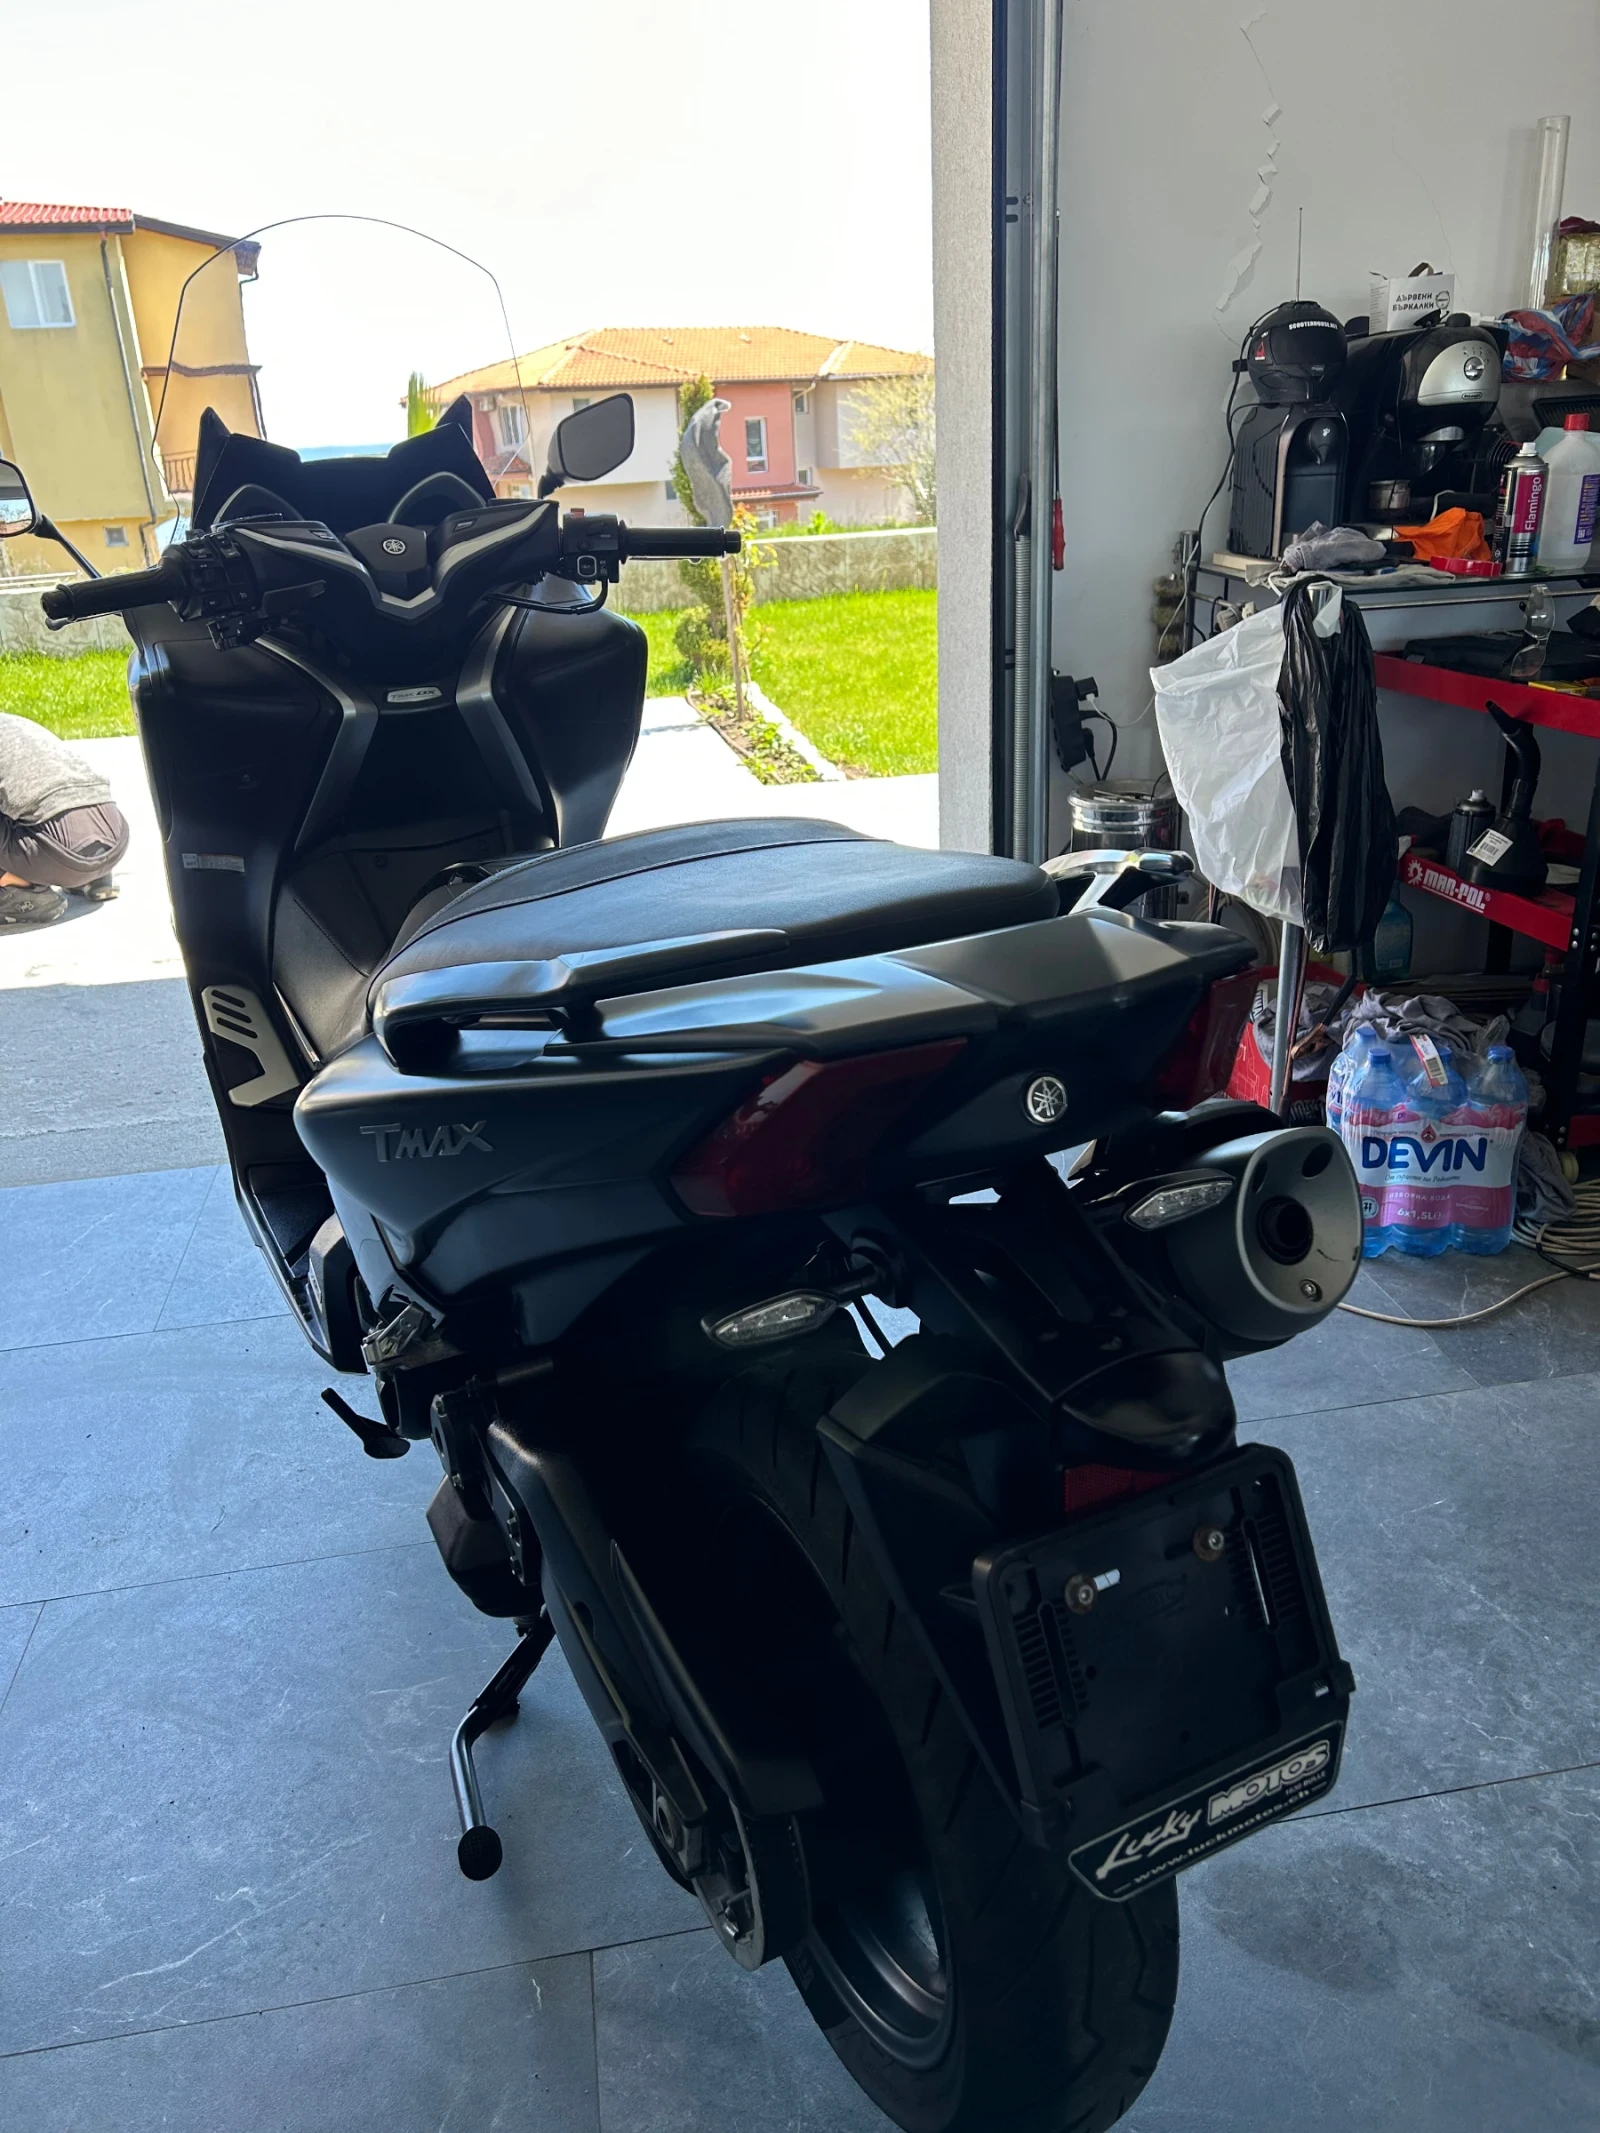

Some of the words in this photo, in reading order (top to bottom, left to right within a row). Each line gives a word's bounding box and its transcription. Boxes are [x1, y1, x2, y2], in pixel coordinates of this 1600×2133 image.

[1392, 301, 1435, 312] БЪРКАЛКИ
[1396, 292, 1433, 303] ДЪРВЕНИ
[1524, 476, 1543, 531] Flamingo
[1362, 1137, 1488, 1173] DEVIN
[1388, 1191, 1427, 1201] ИЗВОРНА
[1095, 1808, 1203, 1881] Lucky
[1206, 1739, 1331, 1827] MOTOS
